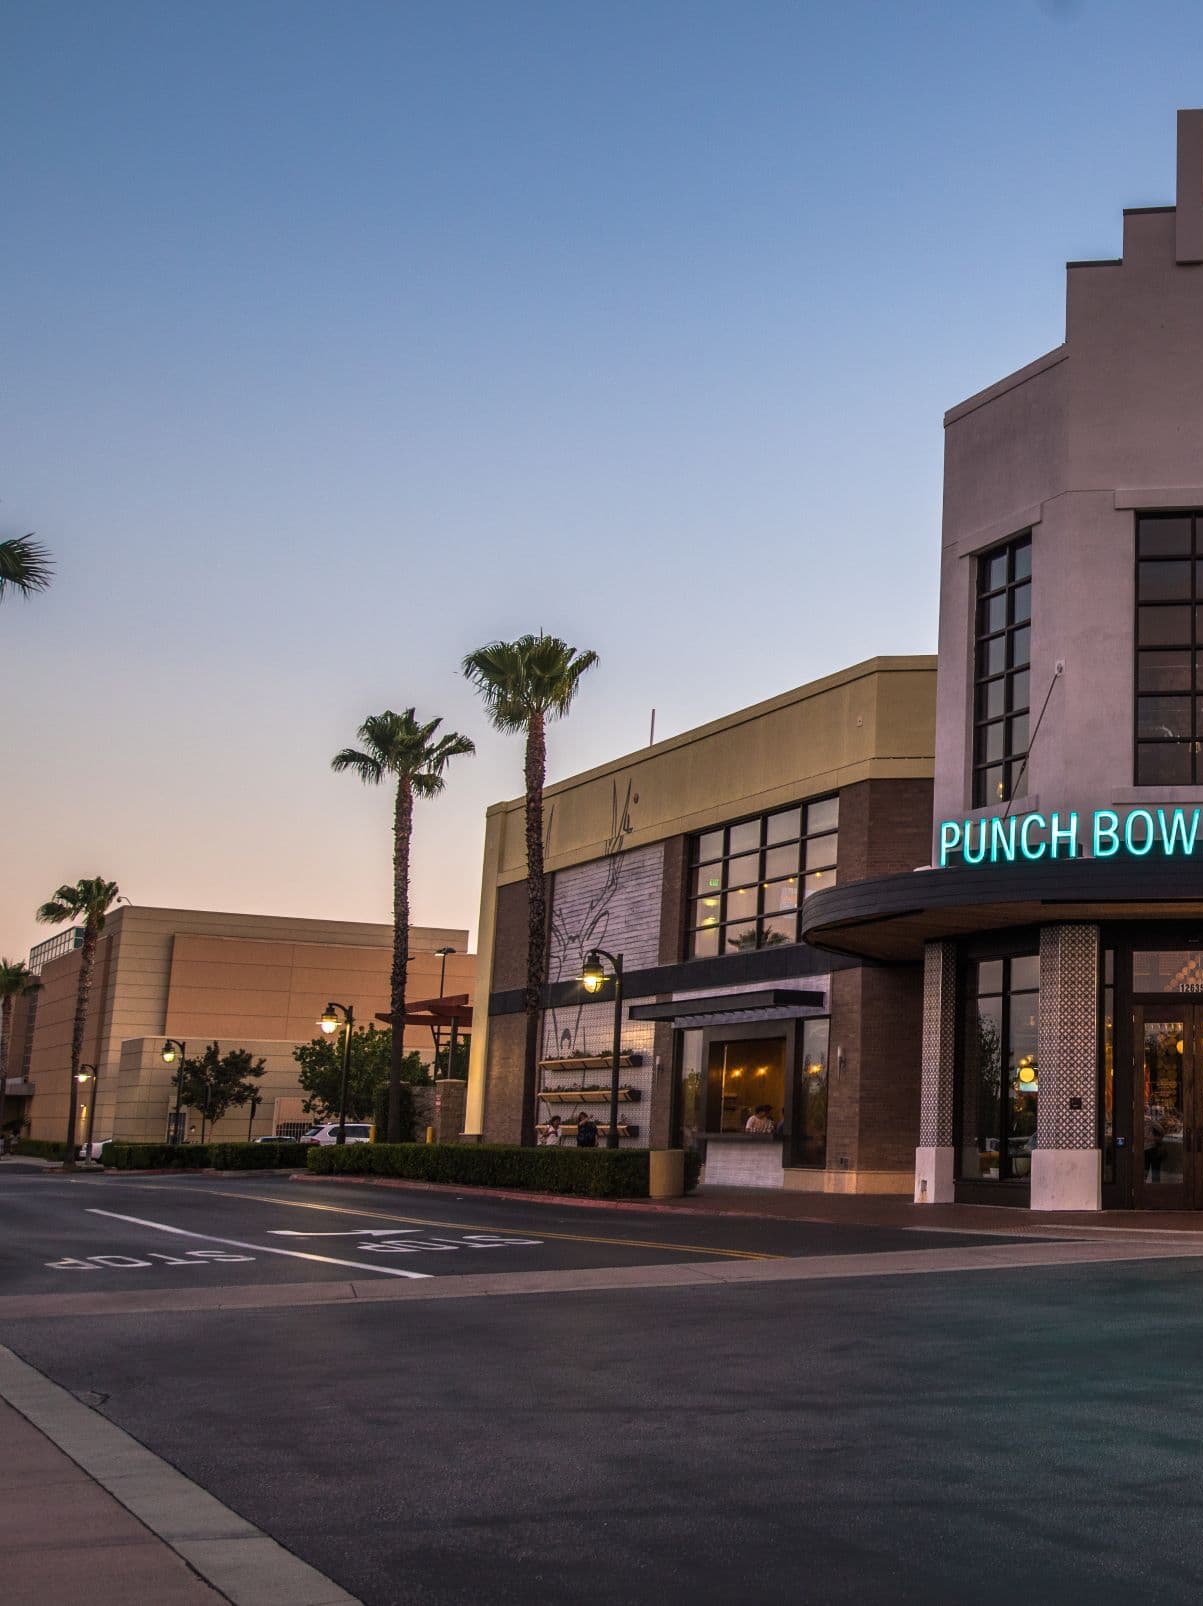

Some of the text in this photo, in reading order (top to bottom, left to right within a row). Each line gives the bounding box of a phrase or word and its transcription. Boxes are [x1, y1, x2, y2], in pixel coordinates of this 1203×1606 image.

[939, 811, 1079, 867] PUNCH
[356, 1235, 545, 1253] STOP
[44, 1250, 257, 1270] STOP
